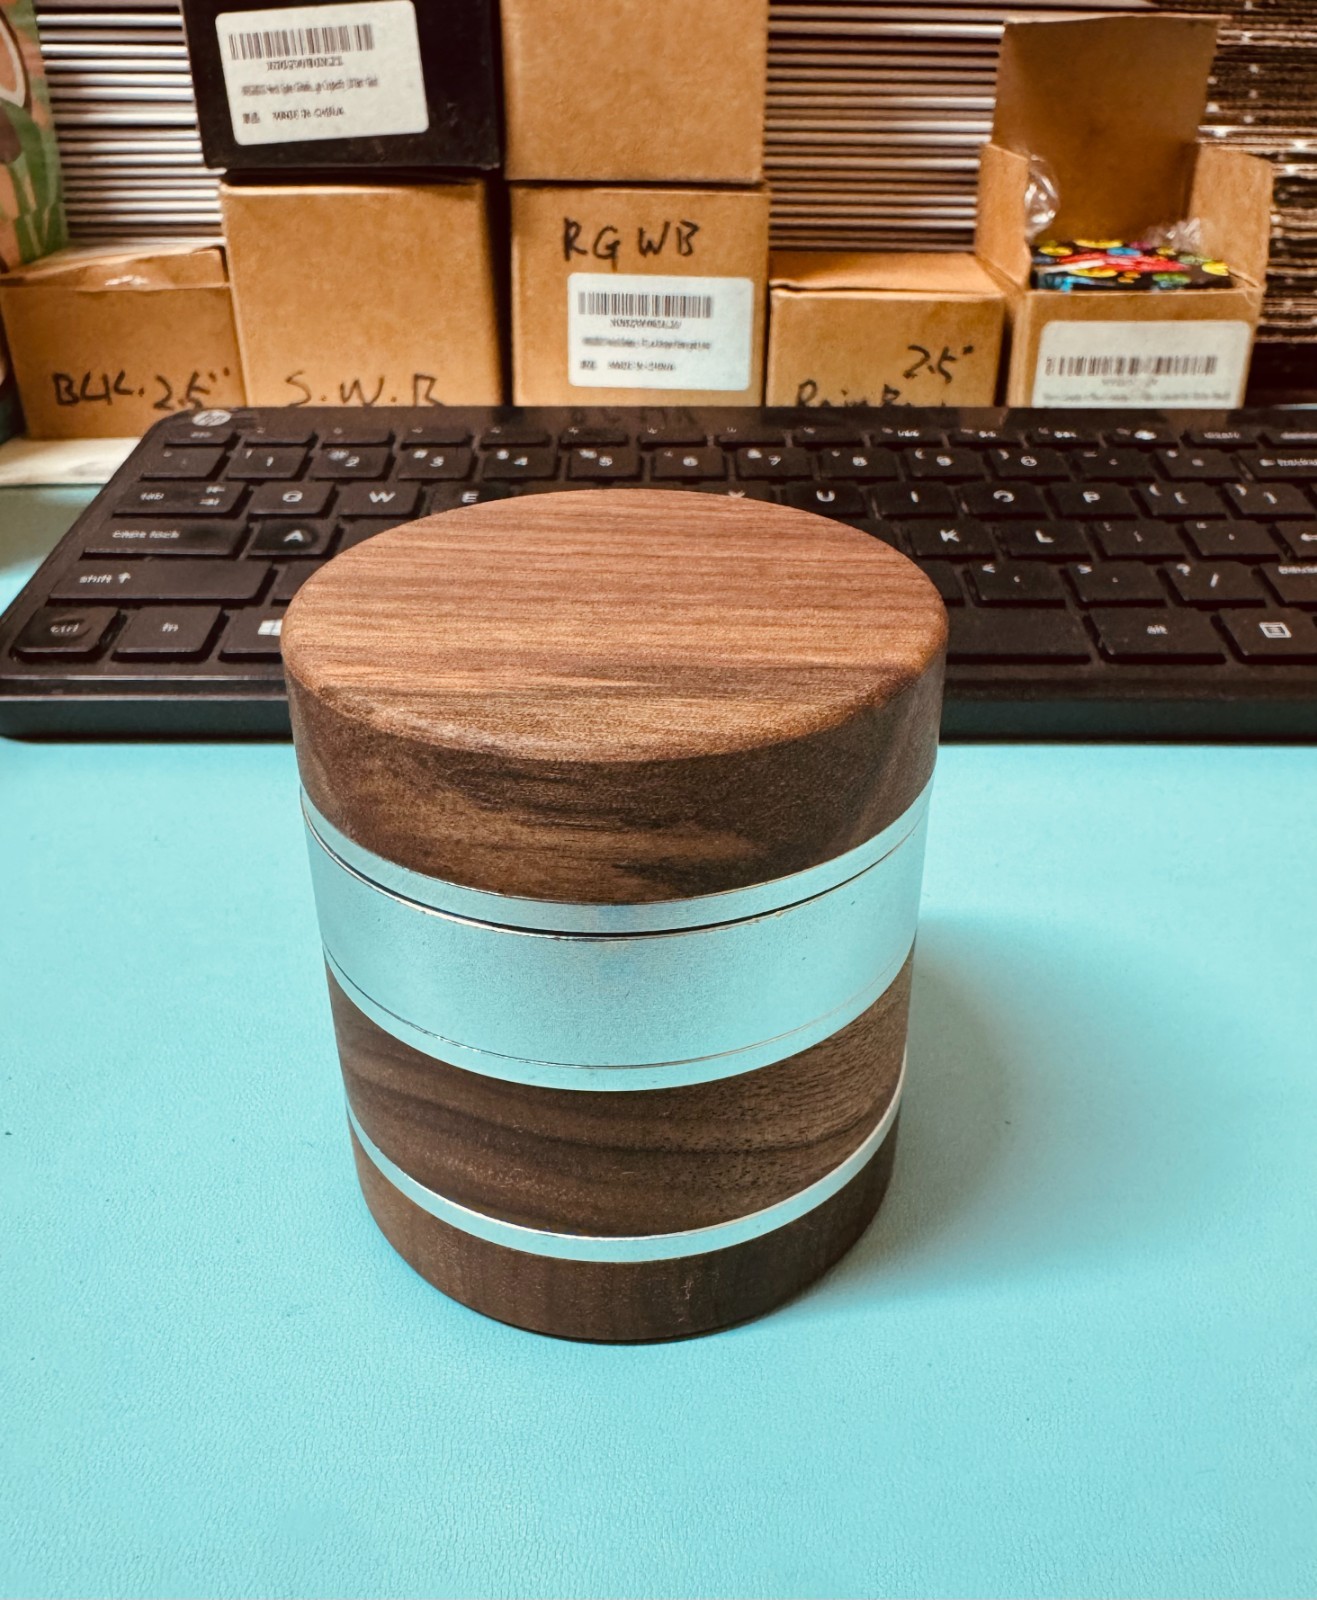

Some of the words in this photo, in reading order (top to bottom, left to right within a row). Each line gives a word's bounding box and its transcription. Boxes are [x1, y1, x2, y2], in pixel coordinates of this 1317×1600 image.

[344, 456, 360, 467] 2
[429, 456, 445, 467] 3
[282, 490, 303, 502] Q
[369, 490, 396, 503] W
[461, 490, 479, 503] E
[816, 489, 836, 502] U
[1082, 490, 1101, 503] P
[284, 529, 304, 543] A
[939, 528, 961, 543] K
[1034, 529, 1055, 543] L
